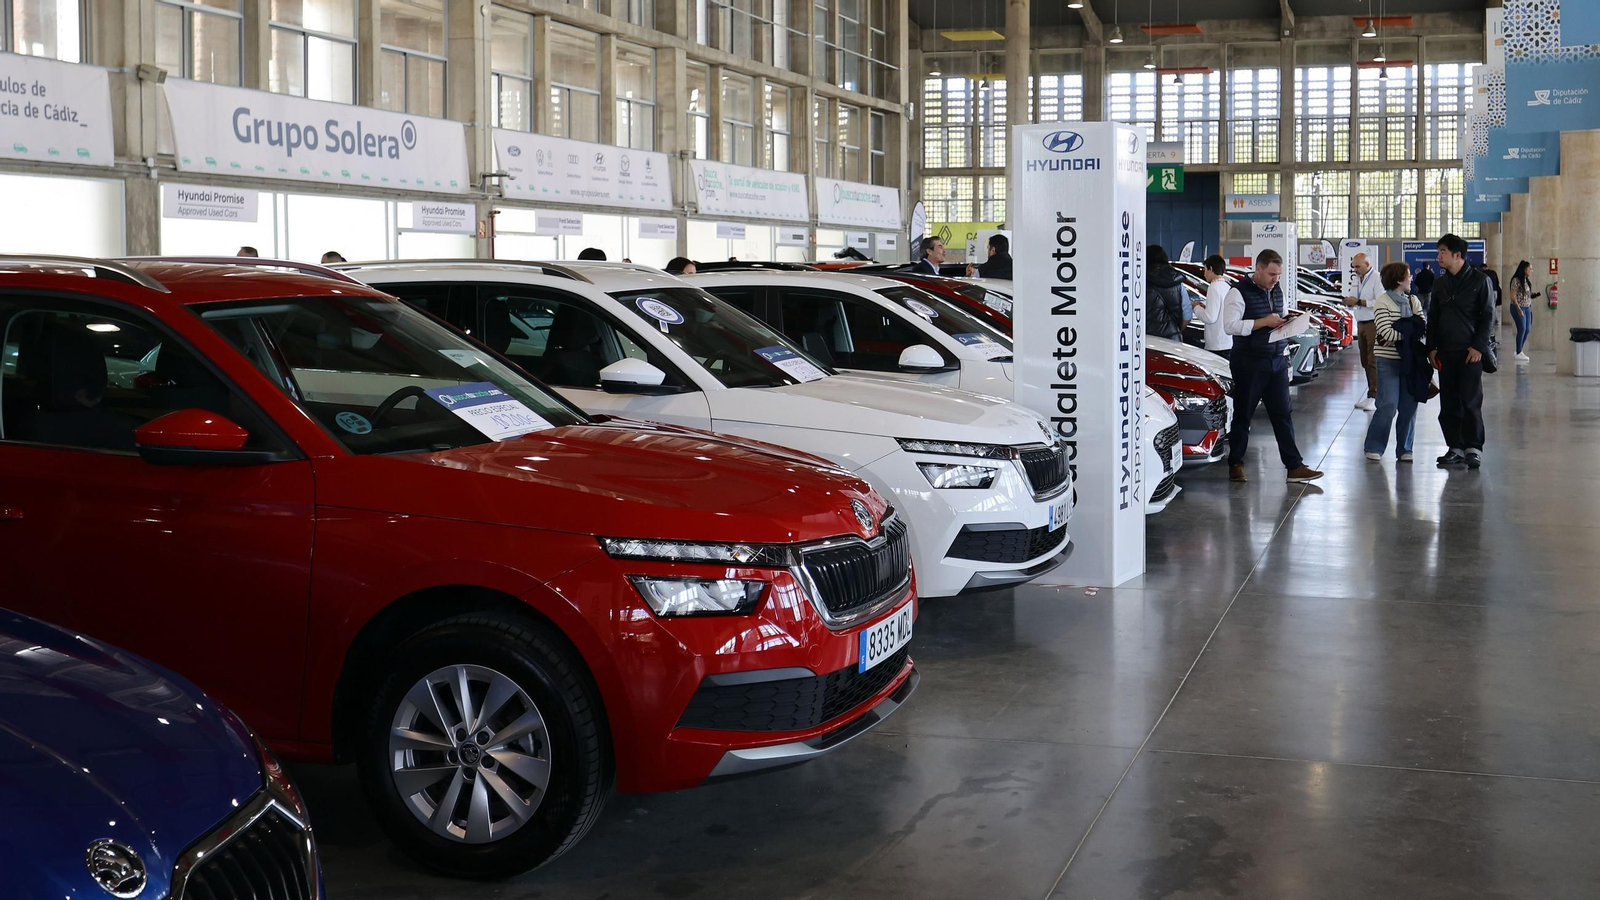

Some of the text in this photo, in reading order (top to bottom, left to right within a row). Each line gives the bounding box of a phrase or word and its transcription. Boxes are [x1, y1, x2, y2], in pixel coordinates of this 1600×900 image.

[31, 80, 46, 97] de
[1552, 88, 1589, 97] Diputación
[1563, 97, 1582, 105] Cádiz
[24, 101, 39, 118] de
[232, 107, 400, 160] Grupo Solera
[1170, 151, 1176, 159] 9
[1520, 147, 1546, 156] Diputación
[1026, 158, 1100, 171] HYUNDAI
[1118, 158, 1144, 174] HYUNDAI
[177, 189, 245, 204] Hyundai Promise
[1248, 199, 1273, 207] ASEOS
[178, 206, 238, 218] Approved Used Cars
[421, 204, 466, 216] Hyundai Promise
[1050, 211, 1078, 316] Motor
[1118, 211, 1131, 511] Hyundai Promise
[1132, 241, 1142, 503] Approved Used Cars
[468, 403, 520, 417] PRECIO ESPECIAL
[869, 620, 895, 662] 8335
